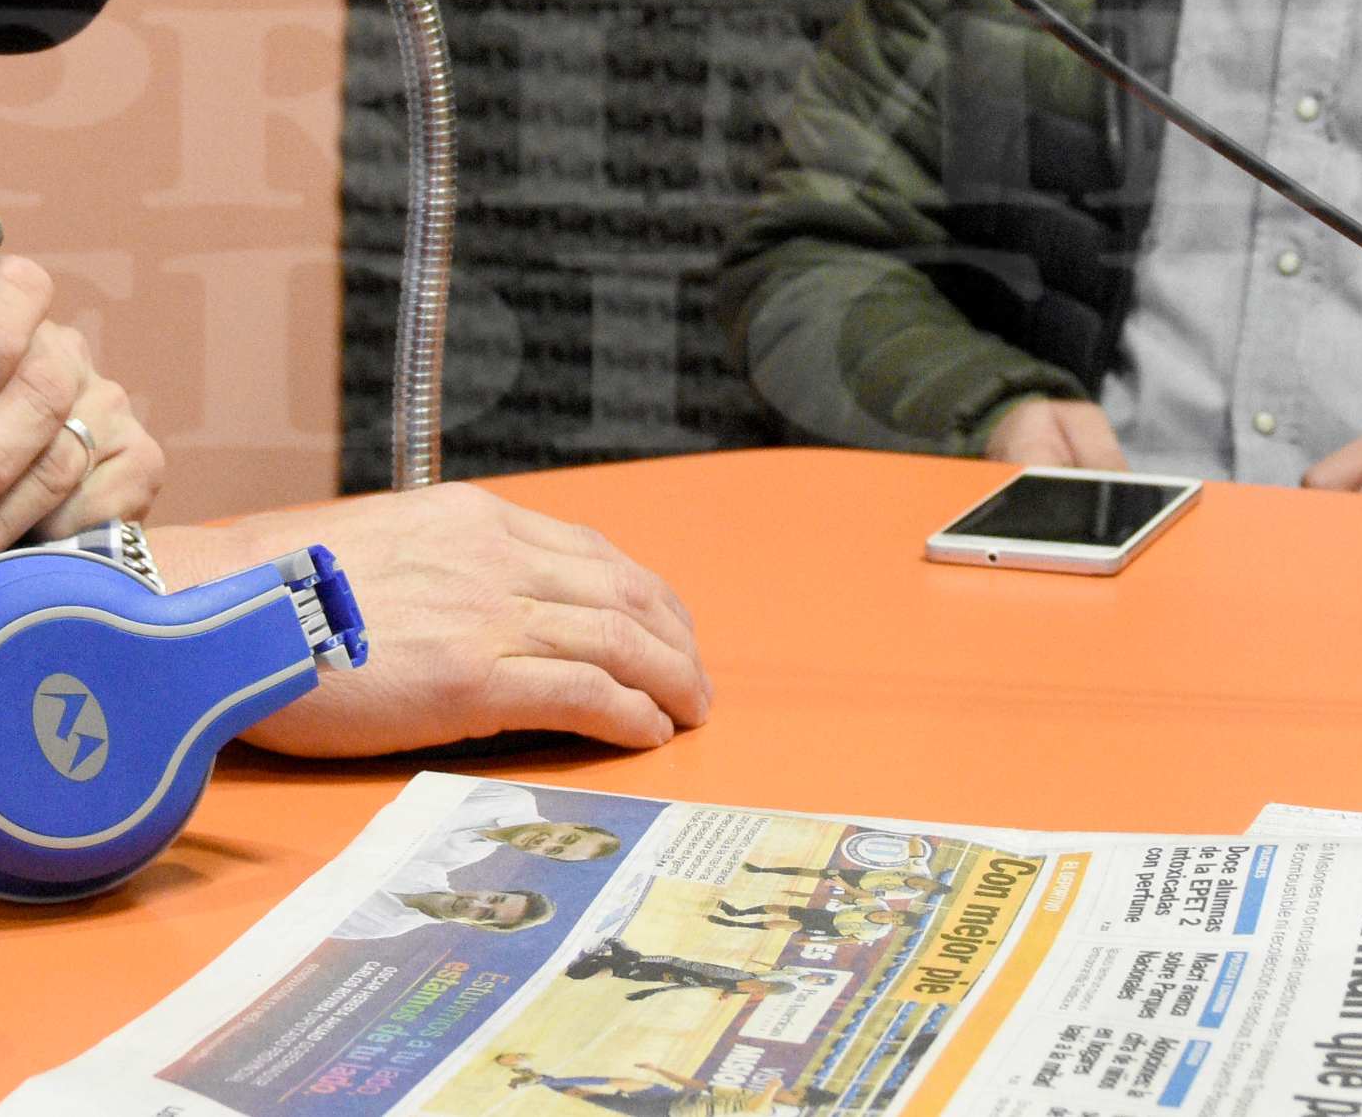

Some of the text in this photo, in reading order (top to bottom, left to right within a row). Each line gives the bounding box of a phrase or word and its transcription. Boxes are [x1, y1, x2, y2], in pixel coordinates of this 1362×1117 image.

[1044, 860, 1079, 912] EL DEPORTIVO
[1124, 847, 1164, 923] con perfume
[1154, 847, 1195, 916] intoxicadas
[1179, 846, 1218, 926] de la EPET 2
[1205, 846, 1249, 932] Doce alumnas
[1278, 851, 1310, 918] combustible
[1309, 852, 1334, 899] Misiones
[914, 857, 1038, 995] Con mejor pie
[1305, 900, 1319, 915] no
[1185, 952, 1218, 983] Macri
[1256, 931, 1289, 988] recolección
[1291, 917, 1319, 970] circularán
[314, 987, 352, 1013] ROVIRA
[340, 960, 381, 988] CARLOS
[362, 965, 399, 992] OSCAR
[1117, 950, 1162, 1001] Nacionales
[1137, 951, 1182, 1019] sobre Parques
[1169, 984, 1200, 1017] avanza
[300, 961, 471, 1097] estamos de tu lado.
[419, 971, 510, 1038] Estuvimos
[391, 1051, 422, 1065] tu
